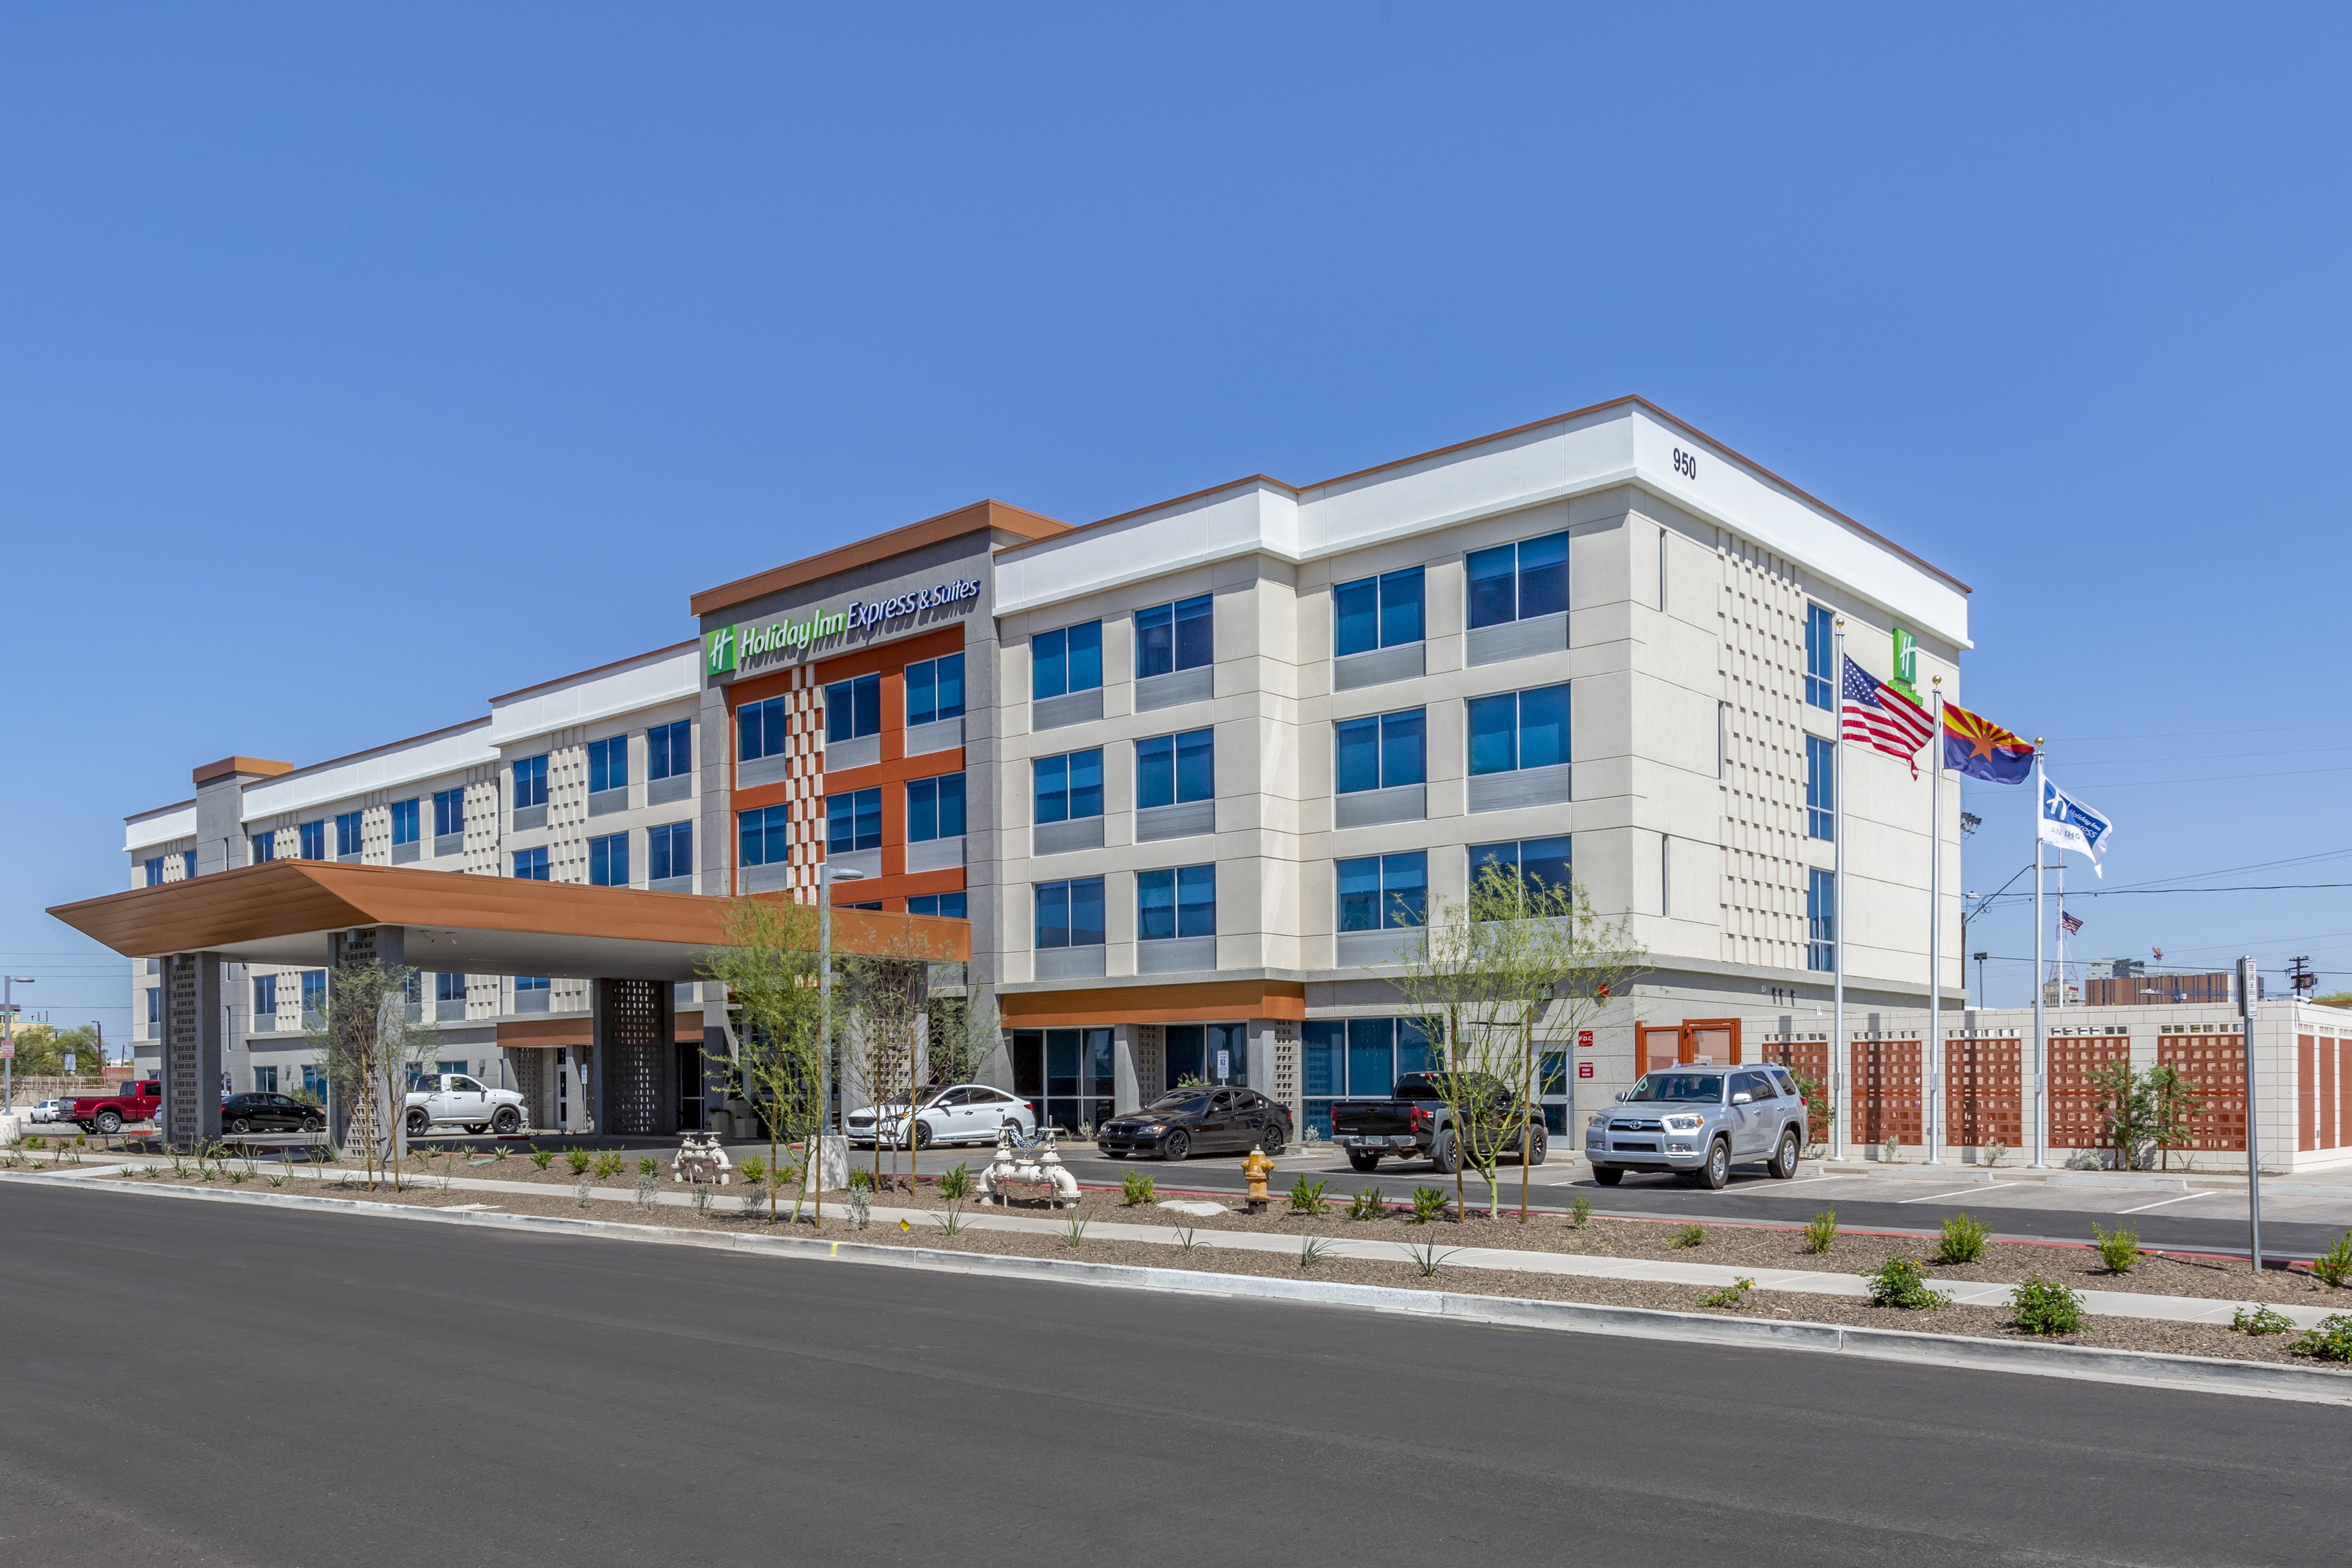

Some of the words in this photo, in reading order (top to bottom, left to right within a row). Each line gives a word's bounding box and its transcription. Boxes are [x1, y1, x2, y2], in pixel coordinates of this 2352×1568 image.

[1673, 448, 1696, 480] 950
[740, 619, 812, 657] Holiday
[813, 608, 844, 639] Inn
[847, 592, 917, 631] Express
[919, 588, 932, 609] &
[932, 579, 979, 606] Suites
[2050, 827, 2062, 835] AN
[2065, 830, 2080, 840] IHG
[2090, 822, 2101, 831] Inn
